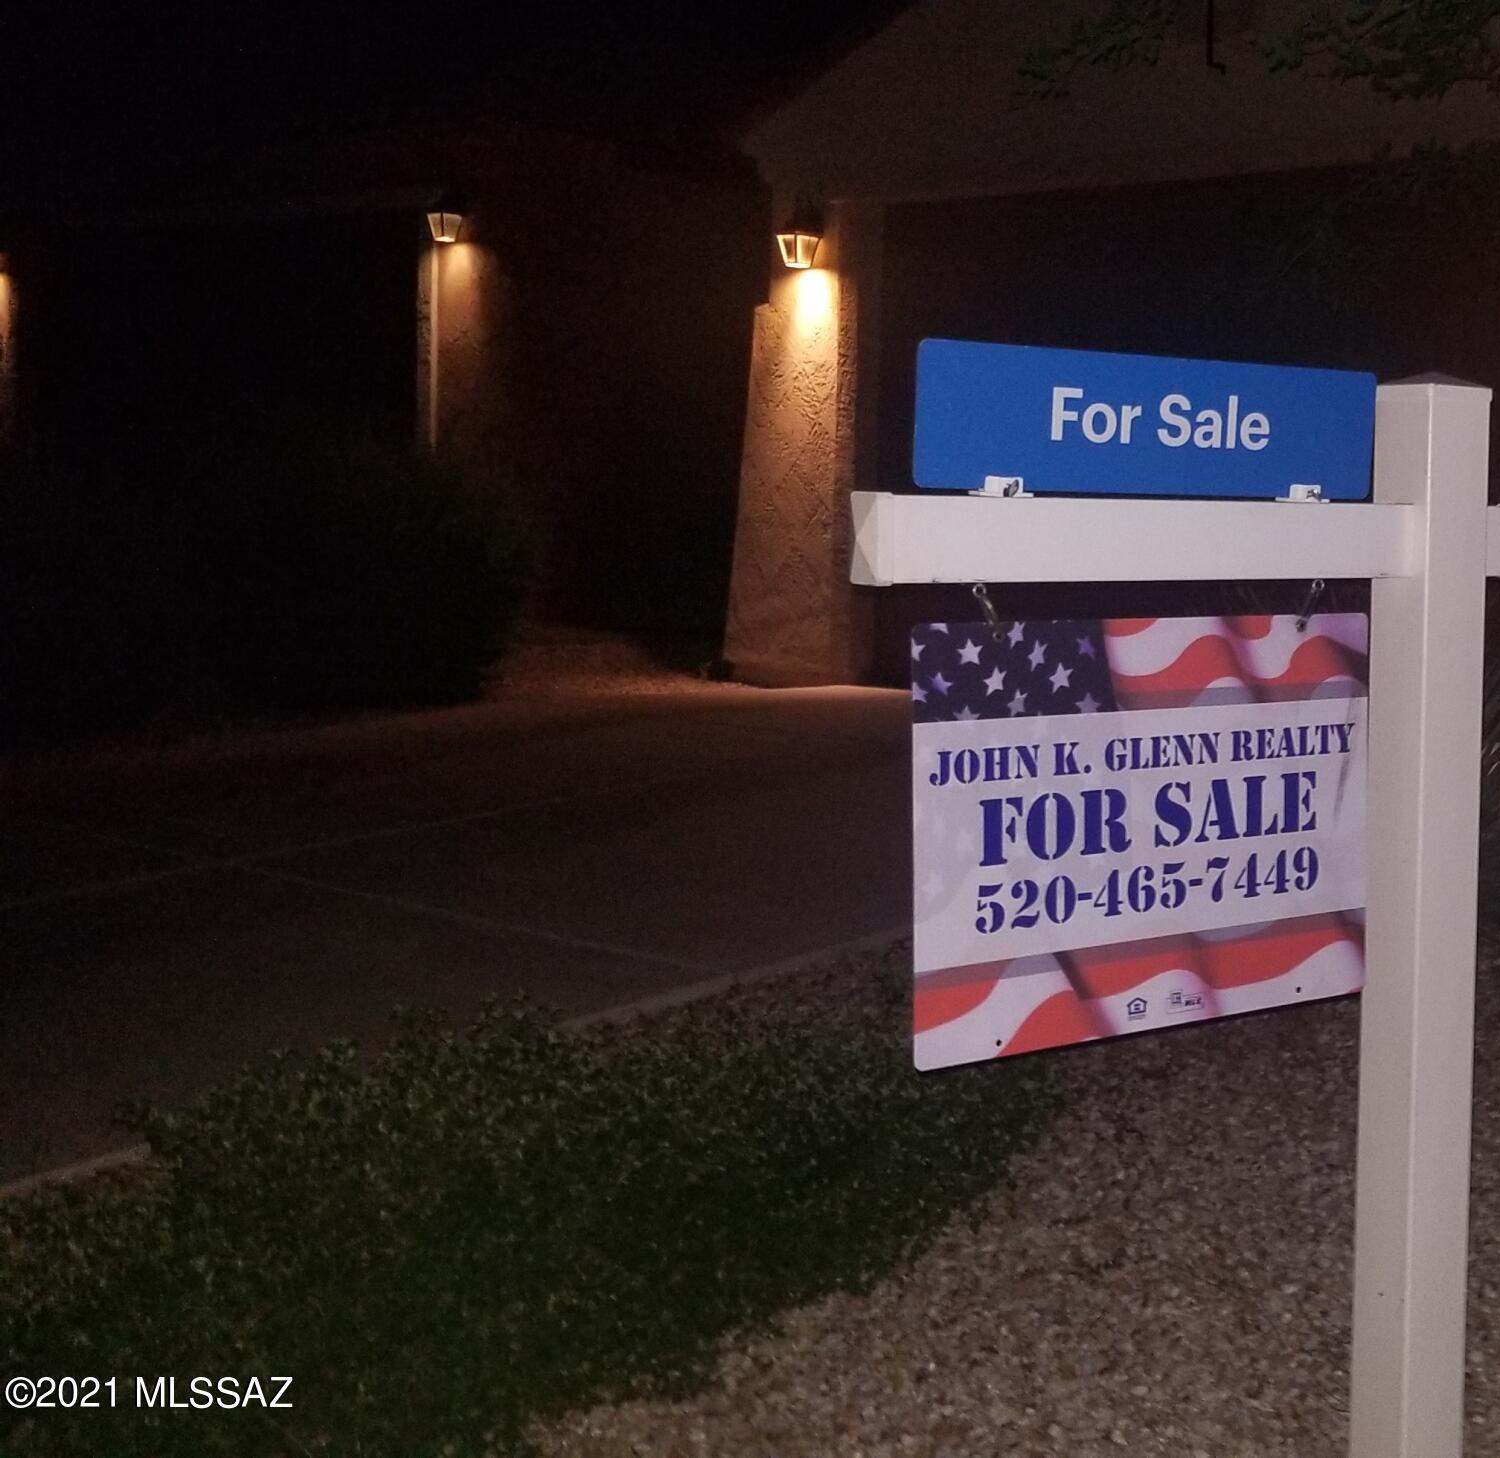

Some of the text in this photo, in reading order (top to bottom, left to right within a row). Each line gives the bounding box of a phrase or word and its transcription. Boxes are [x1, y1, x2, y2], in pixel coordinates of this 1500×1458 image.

[1050, 386, 1270, 451] For Sale
[929, 723, 1356, 787] JOHN K. GLENN REALTY
[978, 770, 1318, 867] FOR SALE
[975, 846, 1319, 934] 520-465-7449
